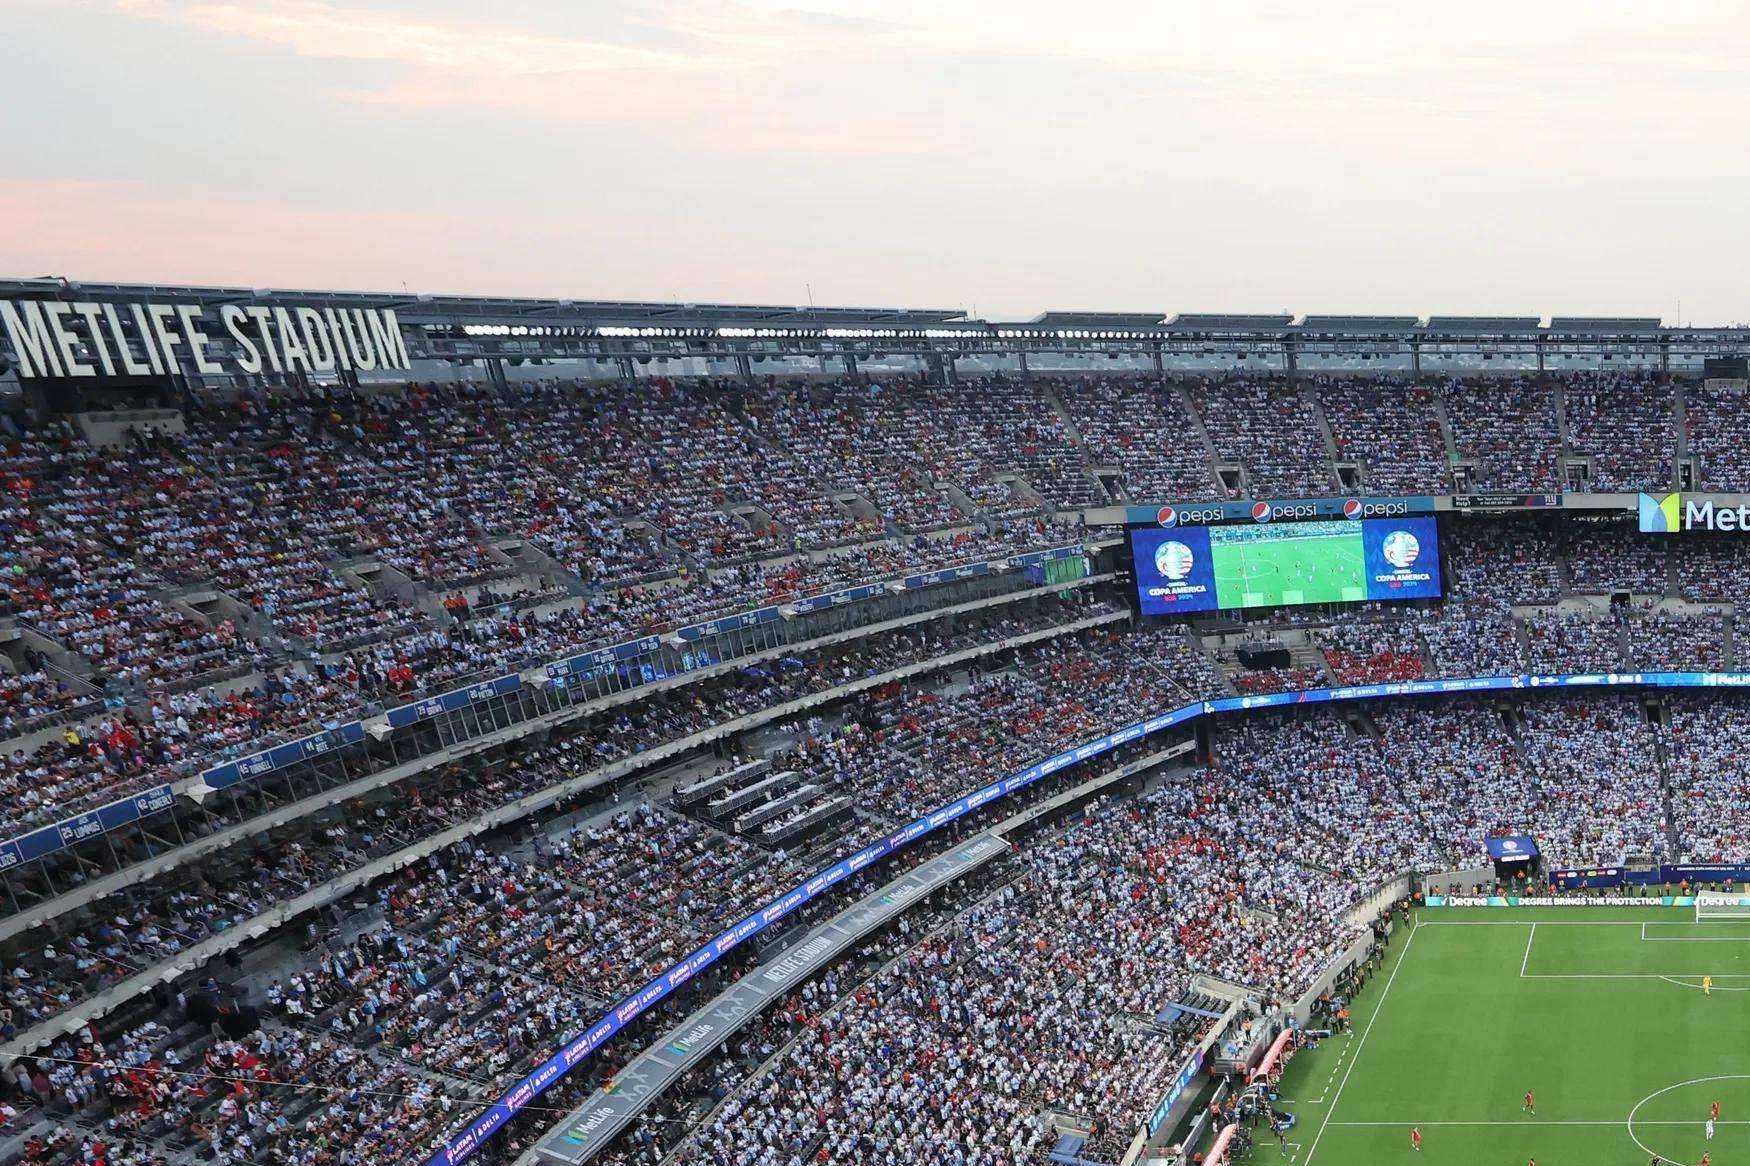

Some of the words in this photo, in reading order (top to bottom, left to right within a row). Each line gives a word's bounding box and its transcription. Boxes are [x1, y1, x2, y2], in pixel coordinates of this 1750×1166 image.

[0, 300, 224, 378] METLIFE
[220, 304, 411, 374] STADIUM
[1179, 506, 1223, 526] pepsi
[1272, 502, 1317, 520] pepsi
[1364, 500, 1408, 518] pepsi
[1450, 897, 1488, 908] Degree
[1519, 897, 1553, 907] DEGREE
[1554, 897, 1586, 907] BRINGS
[1587, 897, 1605, 907] THE
[1606, 897, 1663, 907] PROTECTION
[1702, 897, 1740, 908] Degree
[763, 956, 802, 983] METLIFE
[682, 1023, 714, 1047] MetLife
[577, 1106, 614, 1133] MetLife
[452, 1134, 473, 1156] LATAM
[483, 1113, 500, 1131] DELTA
